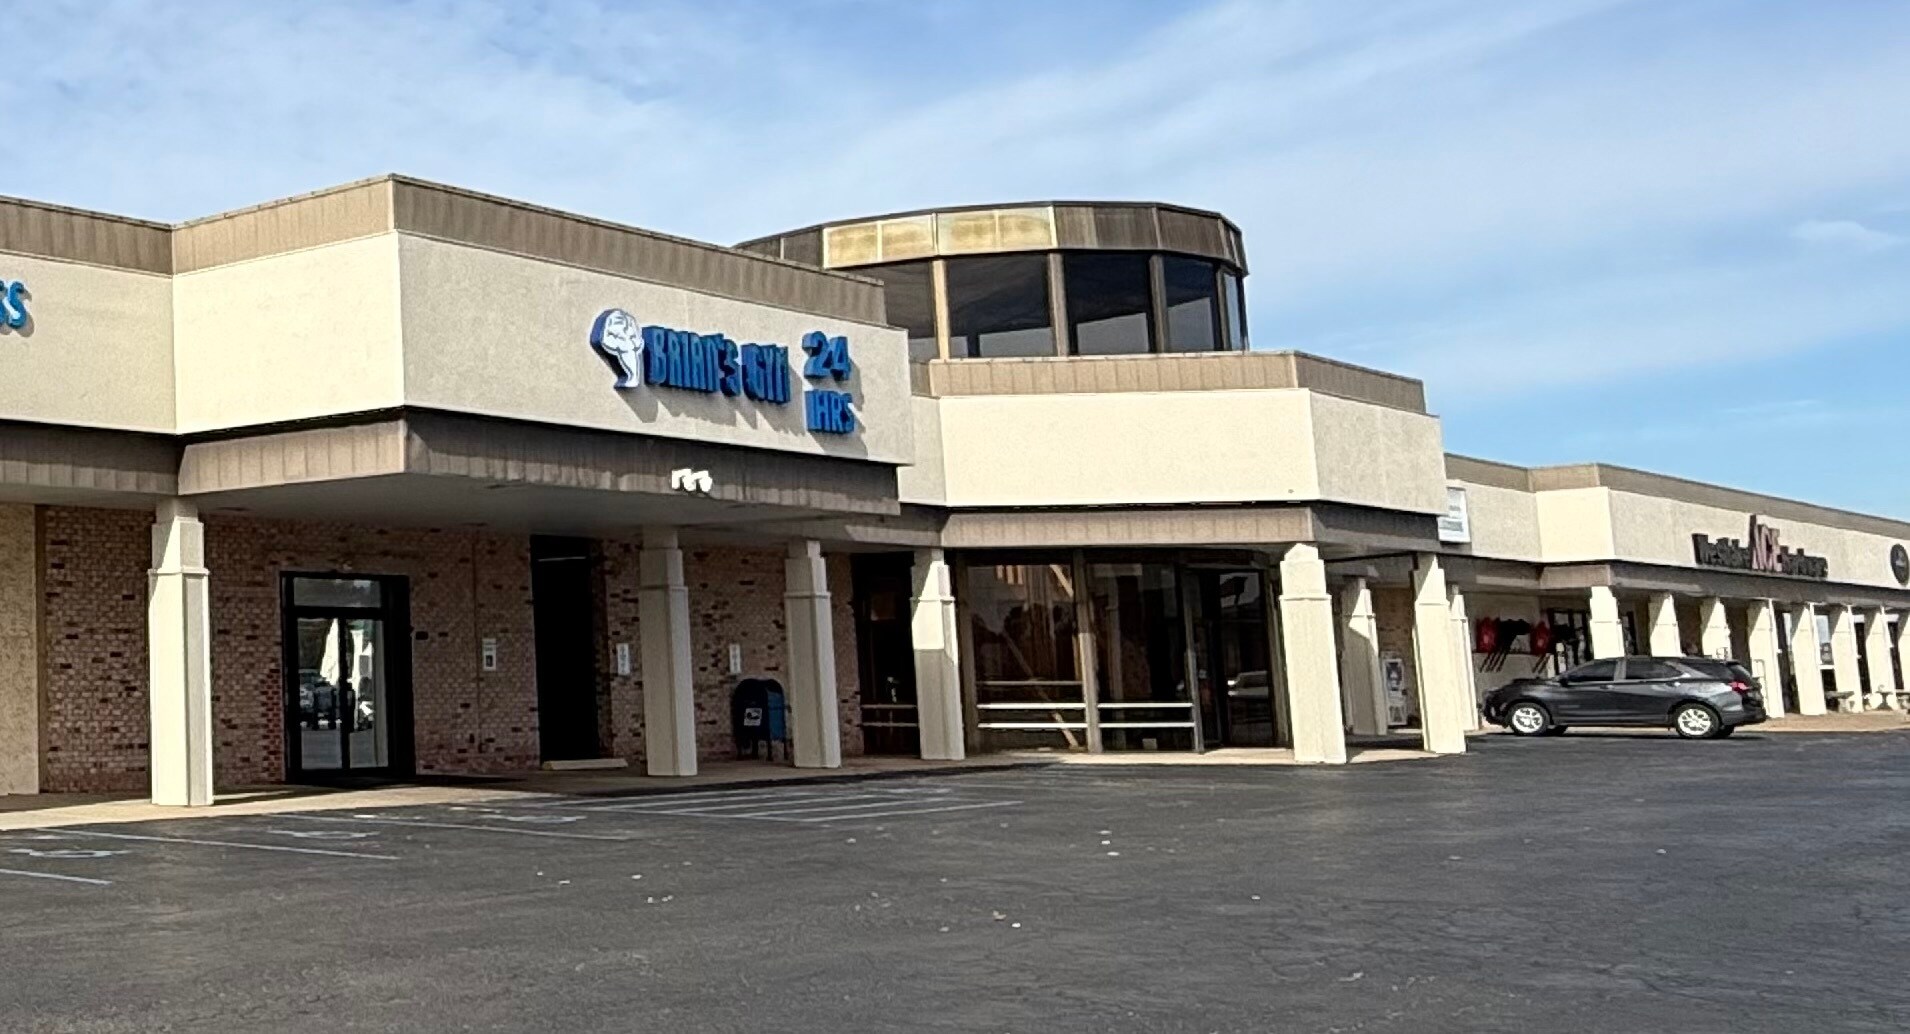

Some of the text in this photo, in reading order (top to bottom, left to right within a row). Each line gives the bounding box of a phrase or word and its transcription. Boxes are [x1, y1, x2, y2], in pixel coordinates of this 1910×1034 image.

[642, 326, 741, 397] BRIAN'S
[802, 331, 850, 381] 24
[805, 389, 855, 434] HRS
